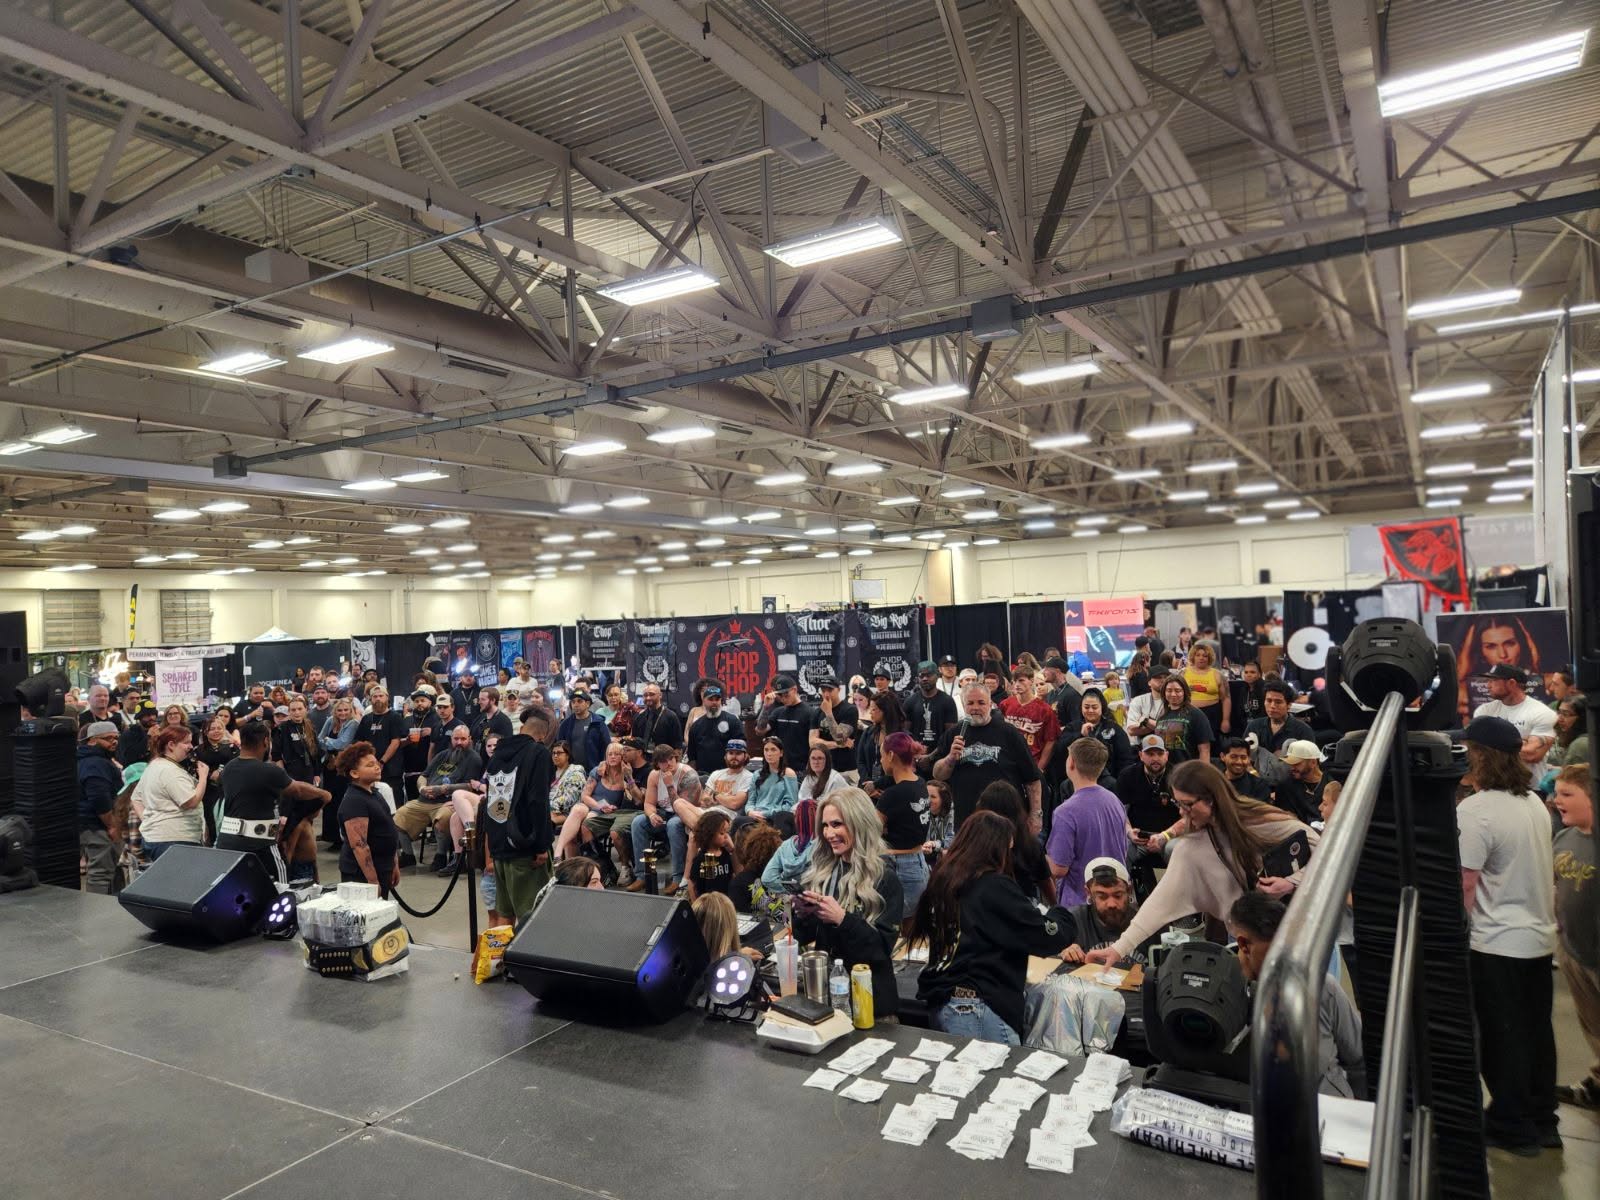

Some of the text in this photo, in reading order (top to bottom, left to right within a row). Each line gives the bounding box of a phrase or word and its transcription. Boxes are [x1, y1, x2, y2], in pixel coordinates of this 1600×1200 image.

[797, 613, 831, 634] Thor
[870, 612, 909, 630] Big Rob
[715, 652, 760, 673] CHOP
[169, 682, 191, 694] STYLE
[1132, 1111, 1212, 1143] CONVENTION
